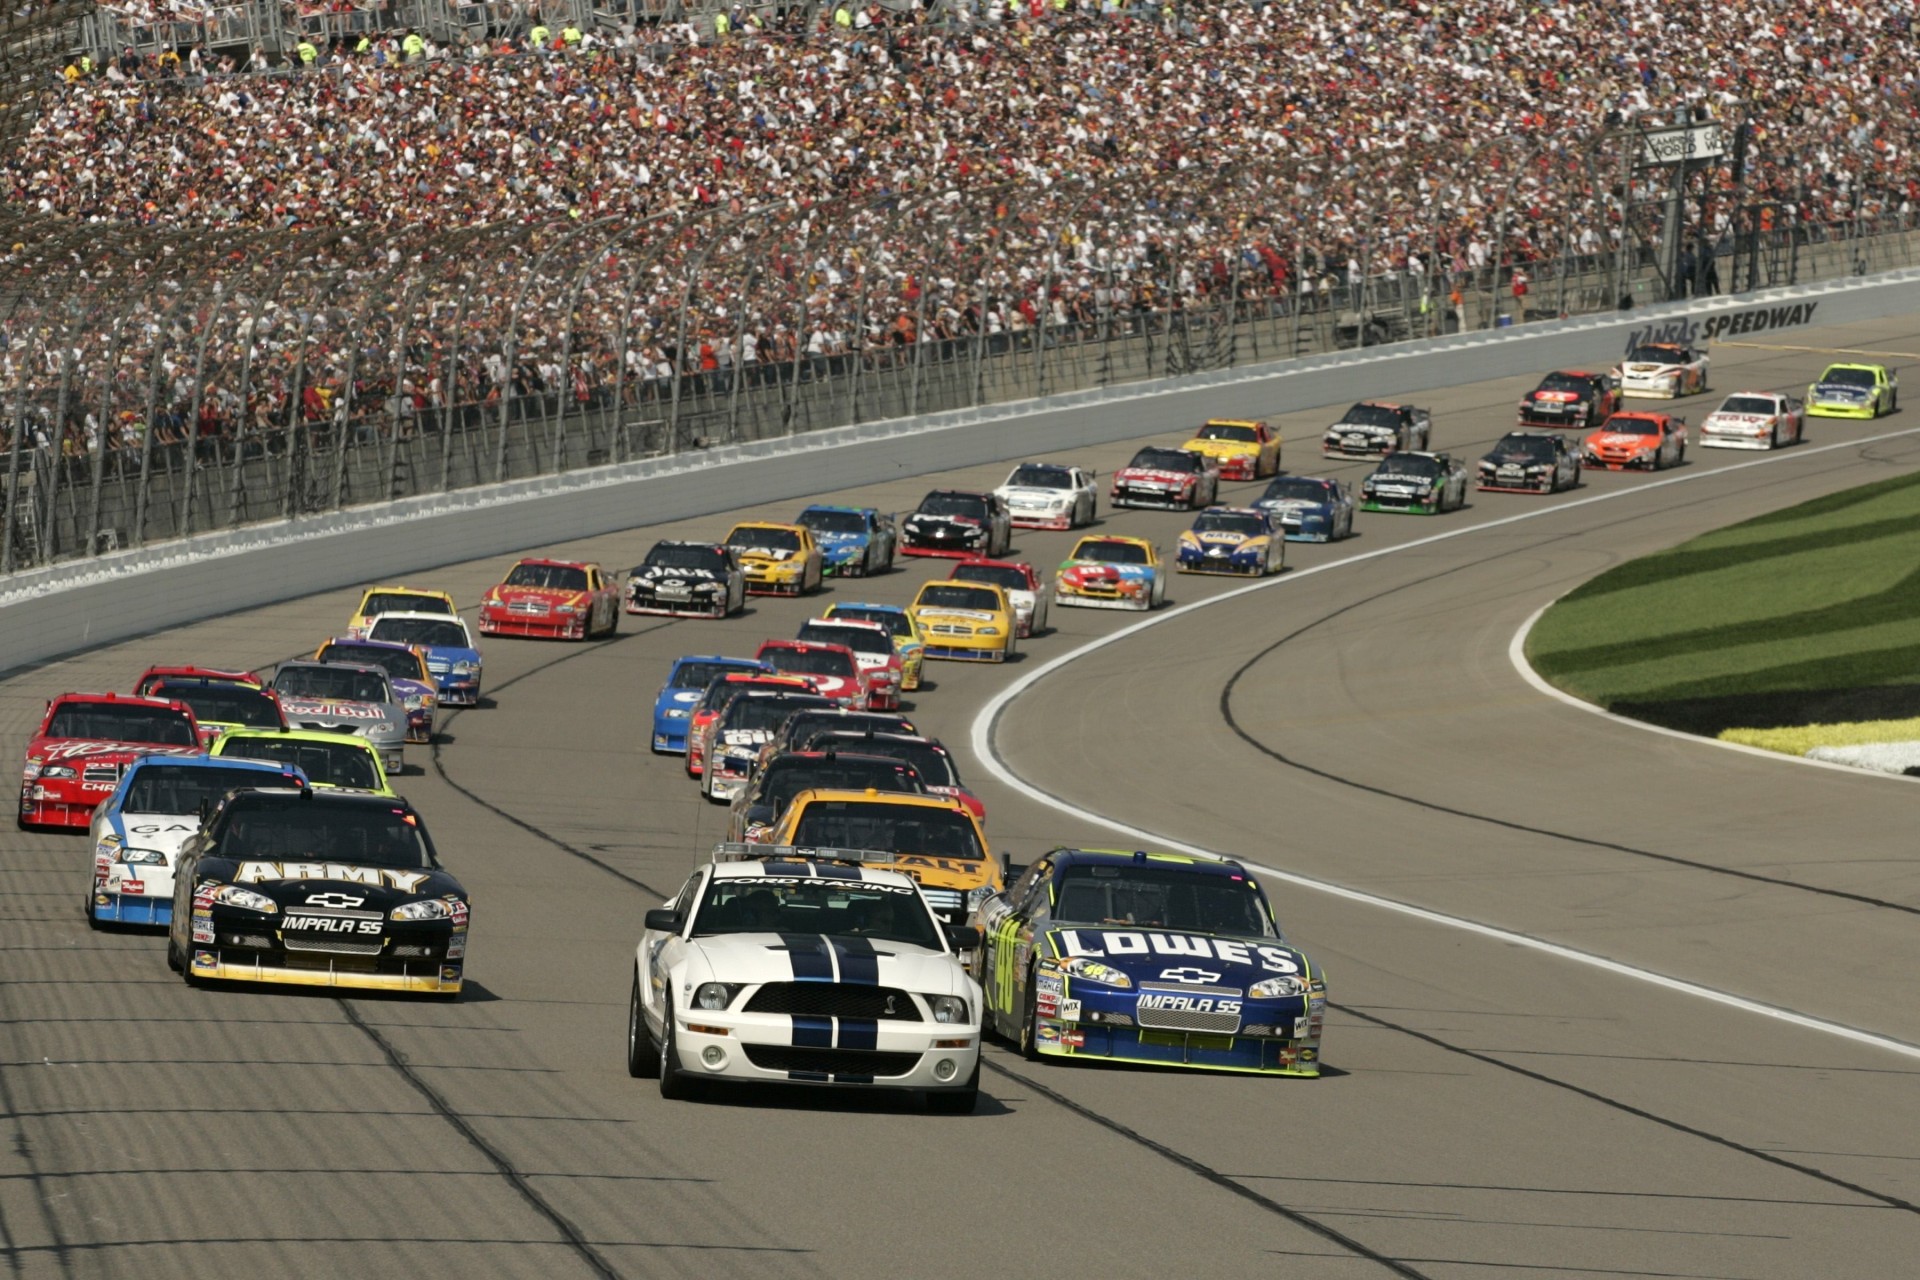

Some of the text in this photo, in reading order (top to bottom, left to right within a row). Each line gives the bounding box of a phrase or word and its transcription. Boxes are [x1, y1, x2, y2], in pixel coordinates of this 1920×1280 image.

[1654, 143, 1697, 156] WORLD
[1625, 302, 1819, 354] KANSAS SPEEDWAY
[1205, 532, 1241, 541] NAPA
[645, 566, 715, 579] JACK
[281, 703, 386, 720] Red Bull
[233, 861, 431, 894] ARMY
[714, 878, 915, 896] FORD RACING
[281, 916, 384, 934] IMPALA SS
[1061, 929, 1299, 974] LOWE'S
[1038, 980, 1061, 992] MAHLE
[1062, 1001, 1079, 1012] WIX
[1137, 993, 1243, 1015] IMPALA SS
[1295, 1020, 1308, 1031] WIX
